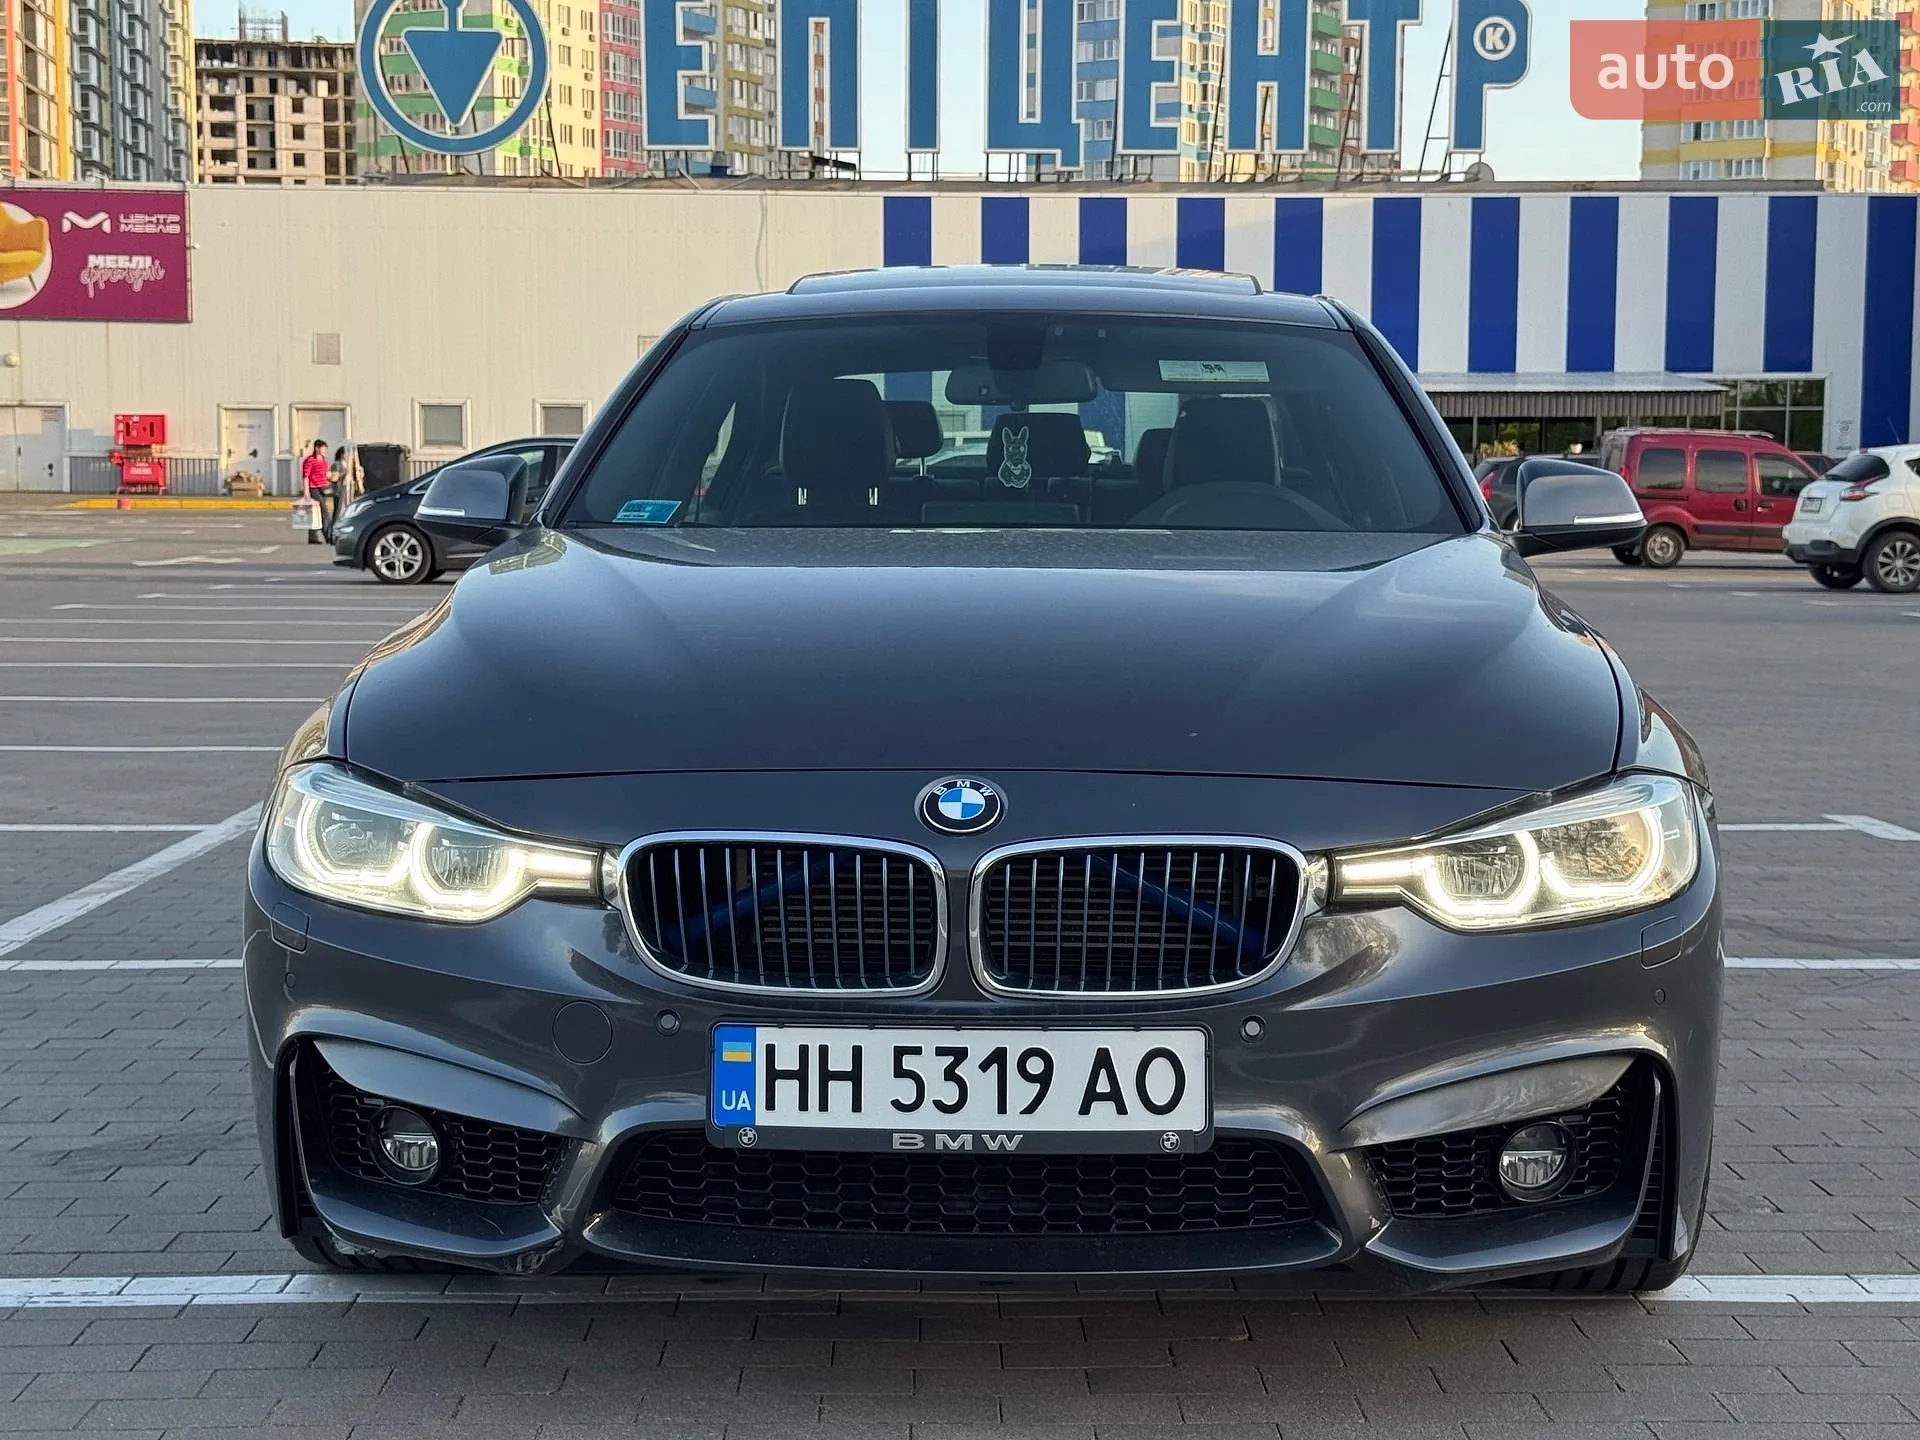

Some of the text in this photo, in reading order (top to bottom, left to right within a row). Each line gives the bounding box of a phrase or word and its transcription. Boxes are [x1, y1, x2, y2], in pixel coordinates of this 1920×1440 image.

[643, 0, 1532, 170] ЕПІЦЕНТР
[119, 213, 181, 223] ЦЕНТР
[87, 254, 152, 269] МЕБЛІ
[933, 780, 994, 797] BMW
[721, 1043, 1187, 1116] UA HH 5319 AO
[892, 1132, 1024, 1152] BMW
